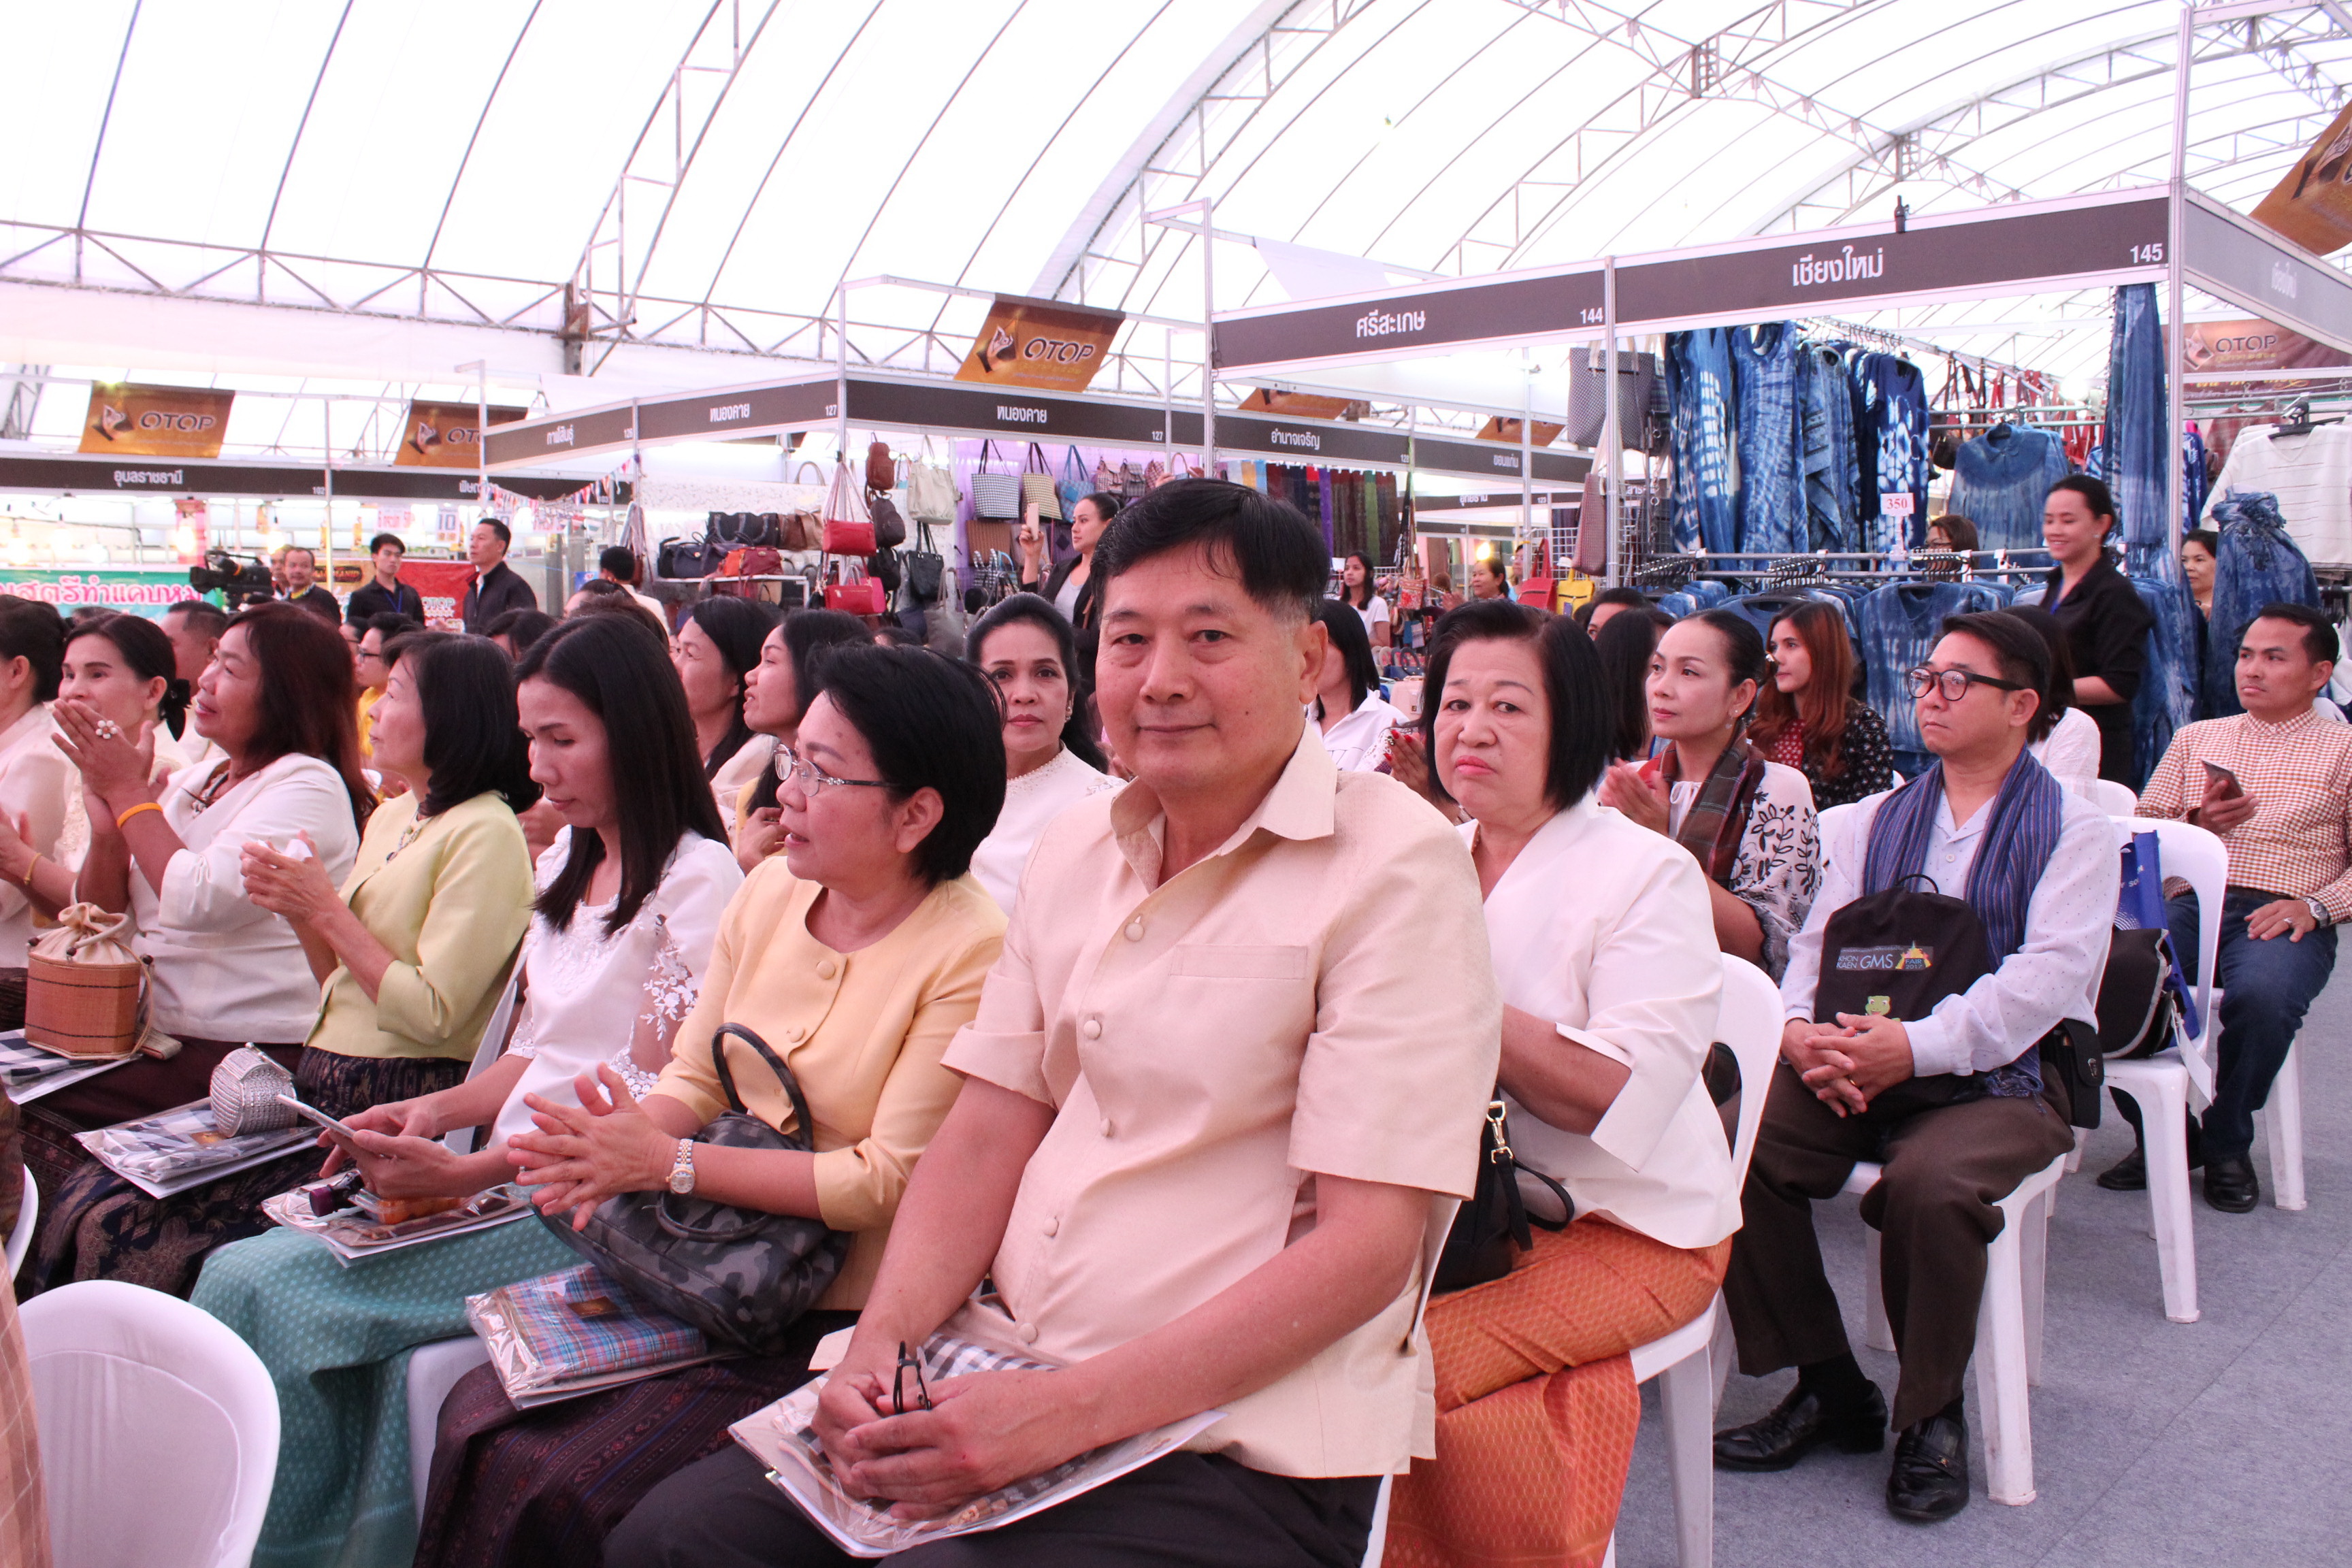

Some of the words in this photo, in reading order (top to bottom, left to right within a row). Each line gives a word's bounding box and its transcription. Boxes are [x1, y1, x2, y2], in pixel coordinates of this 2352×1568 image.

[2130, 242, 2163, 263] 145
[1792, 245, 1884, 287] เชียงใหม่
[1356, 309, 1426, 338] ศรีสะเกษ
[1580, 307, 1603, 324] 144
[1024, 337, 1095, 363] OTOP
[2216, 335, 2277, 353] OTOP
[710, 404, 750, 422] หนองคาย
[826, 405, 837, 416] 127
[997, 406, 1047, 423] หนองคาย
[139, 411, 215, 432] OTOP
[446, 427, 480, 444] OT
[1152, 431, 1164, 441] 127
[1271, 428, 1320, 451] อำนาจเจริญ
[114, 469, 184, 488] อุบลราชธานี
[1886, 497, 1908, 509] 350
[438, 514, 456, 530] 10
[1860, 953, 1893, 969] GMS
